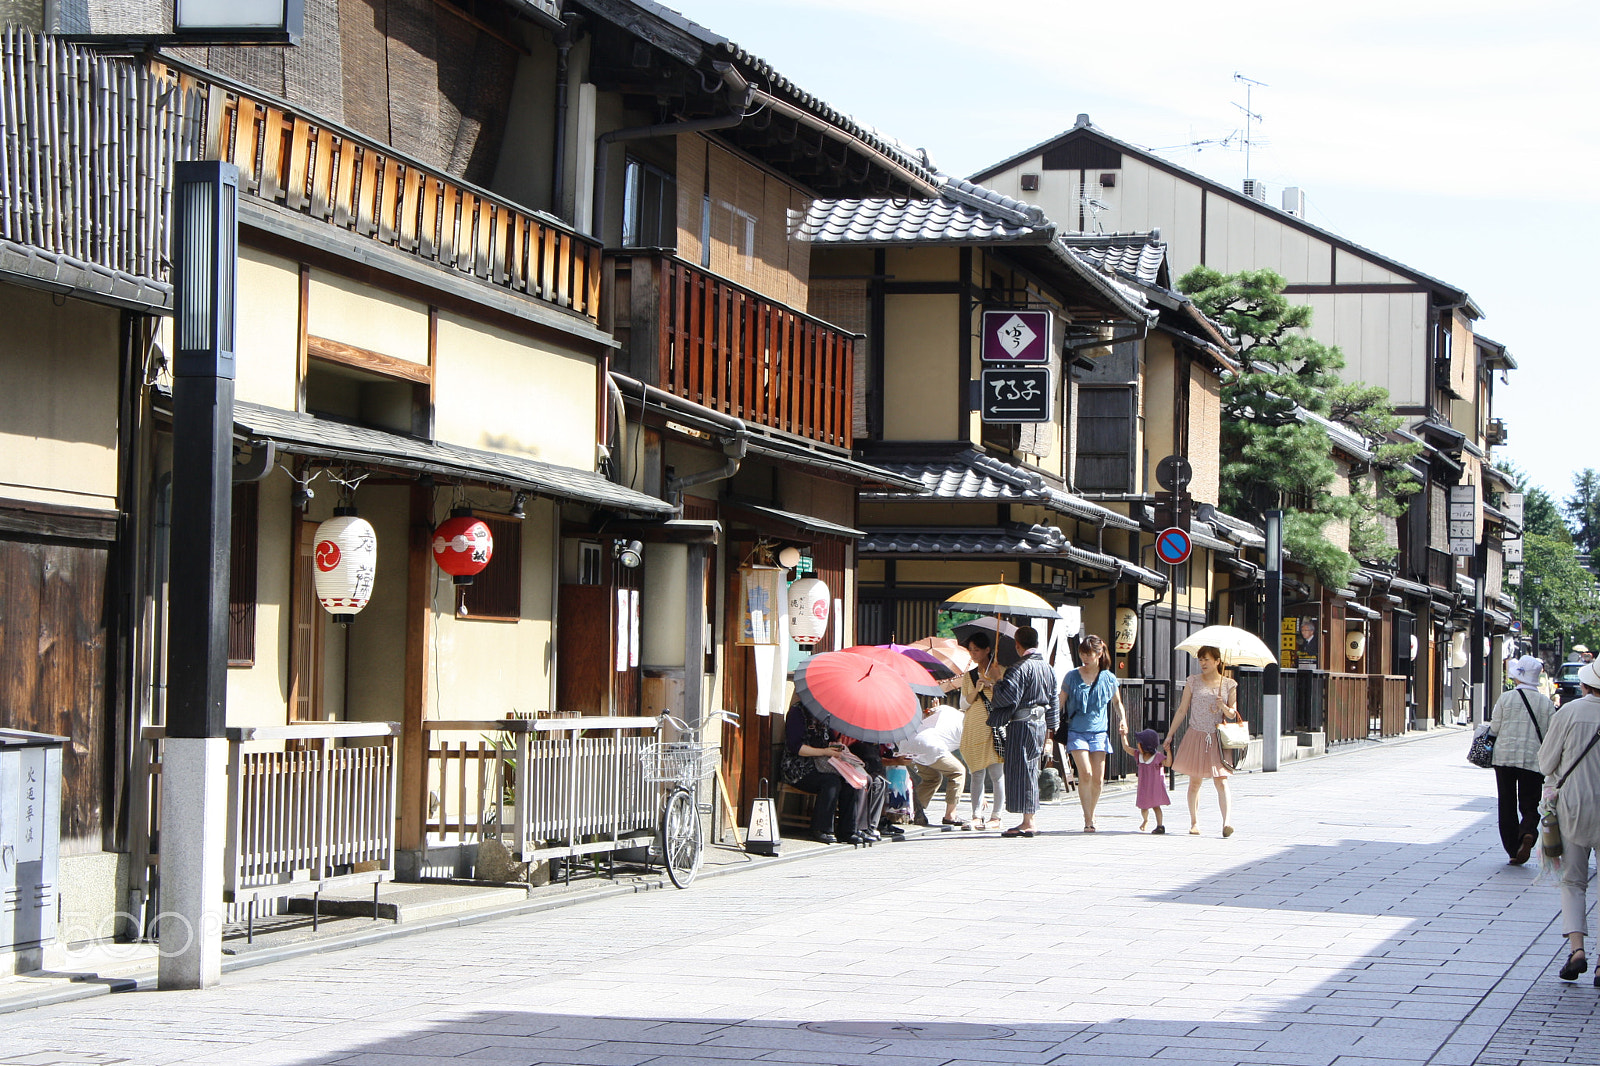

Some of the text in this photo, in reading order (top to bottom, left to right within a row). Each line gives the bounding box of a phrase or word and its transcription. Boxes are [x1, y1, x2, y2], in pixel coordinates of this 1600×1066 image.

[1005, 326, 1022, 349] ゆう
[989, 379, 1041, 401] てる子
